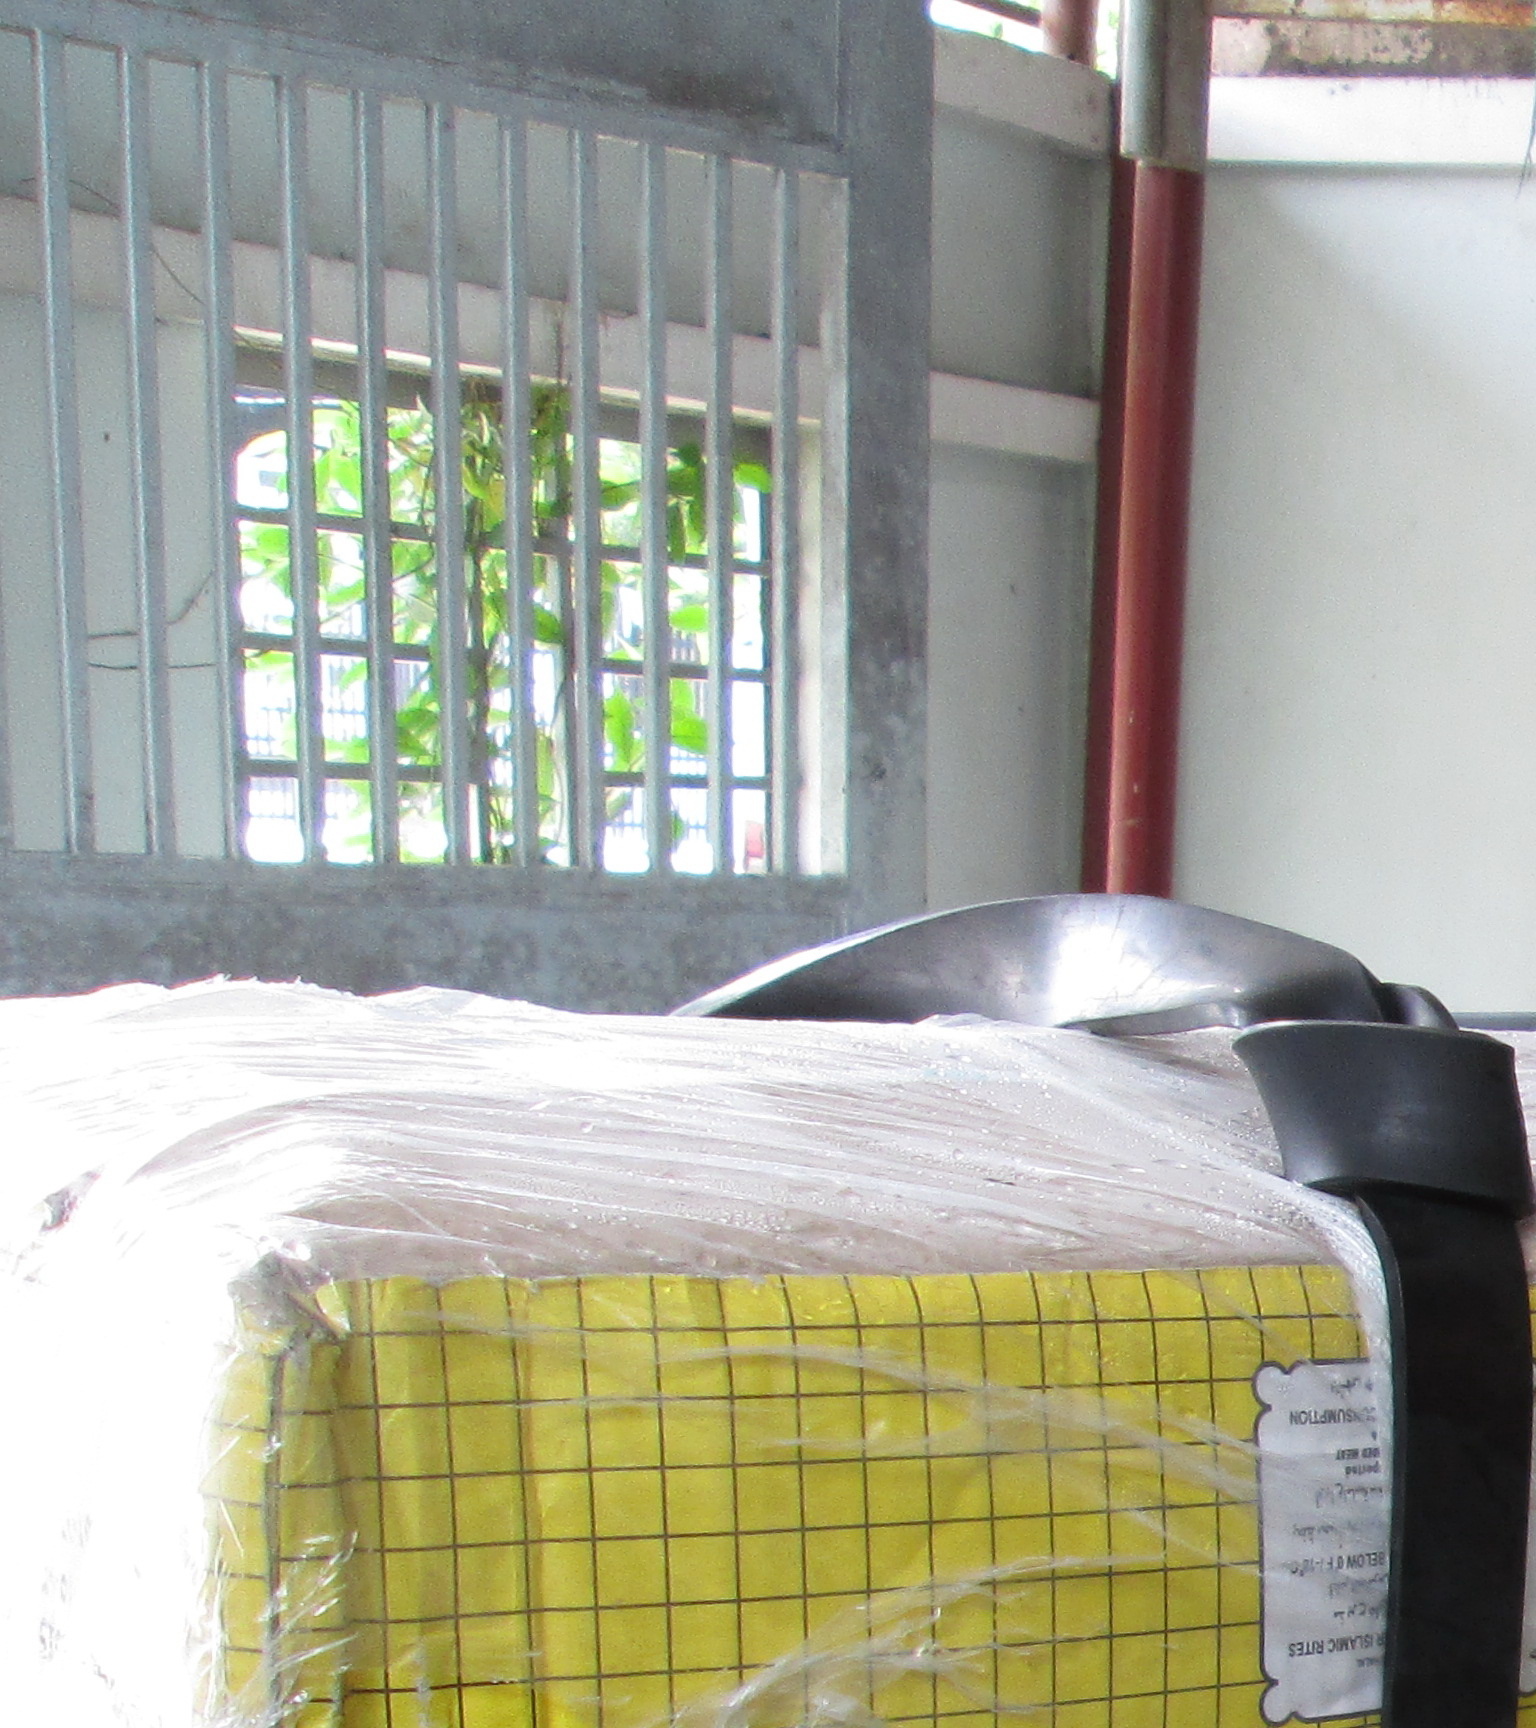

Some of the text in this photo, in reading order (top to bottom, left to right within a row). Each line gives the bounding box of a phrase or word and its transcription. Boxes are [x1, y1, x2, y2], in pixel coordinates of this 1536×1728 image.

[1345, 1551, 1386, 1570] BELOW
[1288, 1633, 1373, 1658] ISLAMIC RITES
